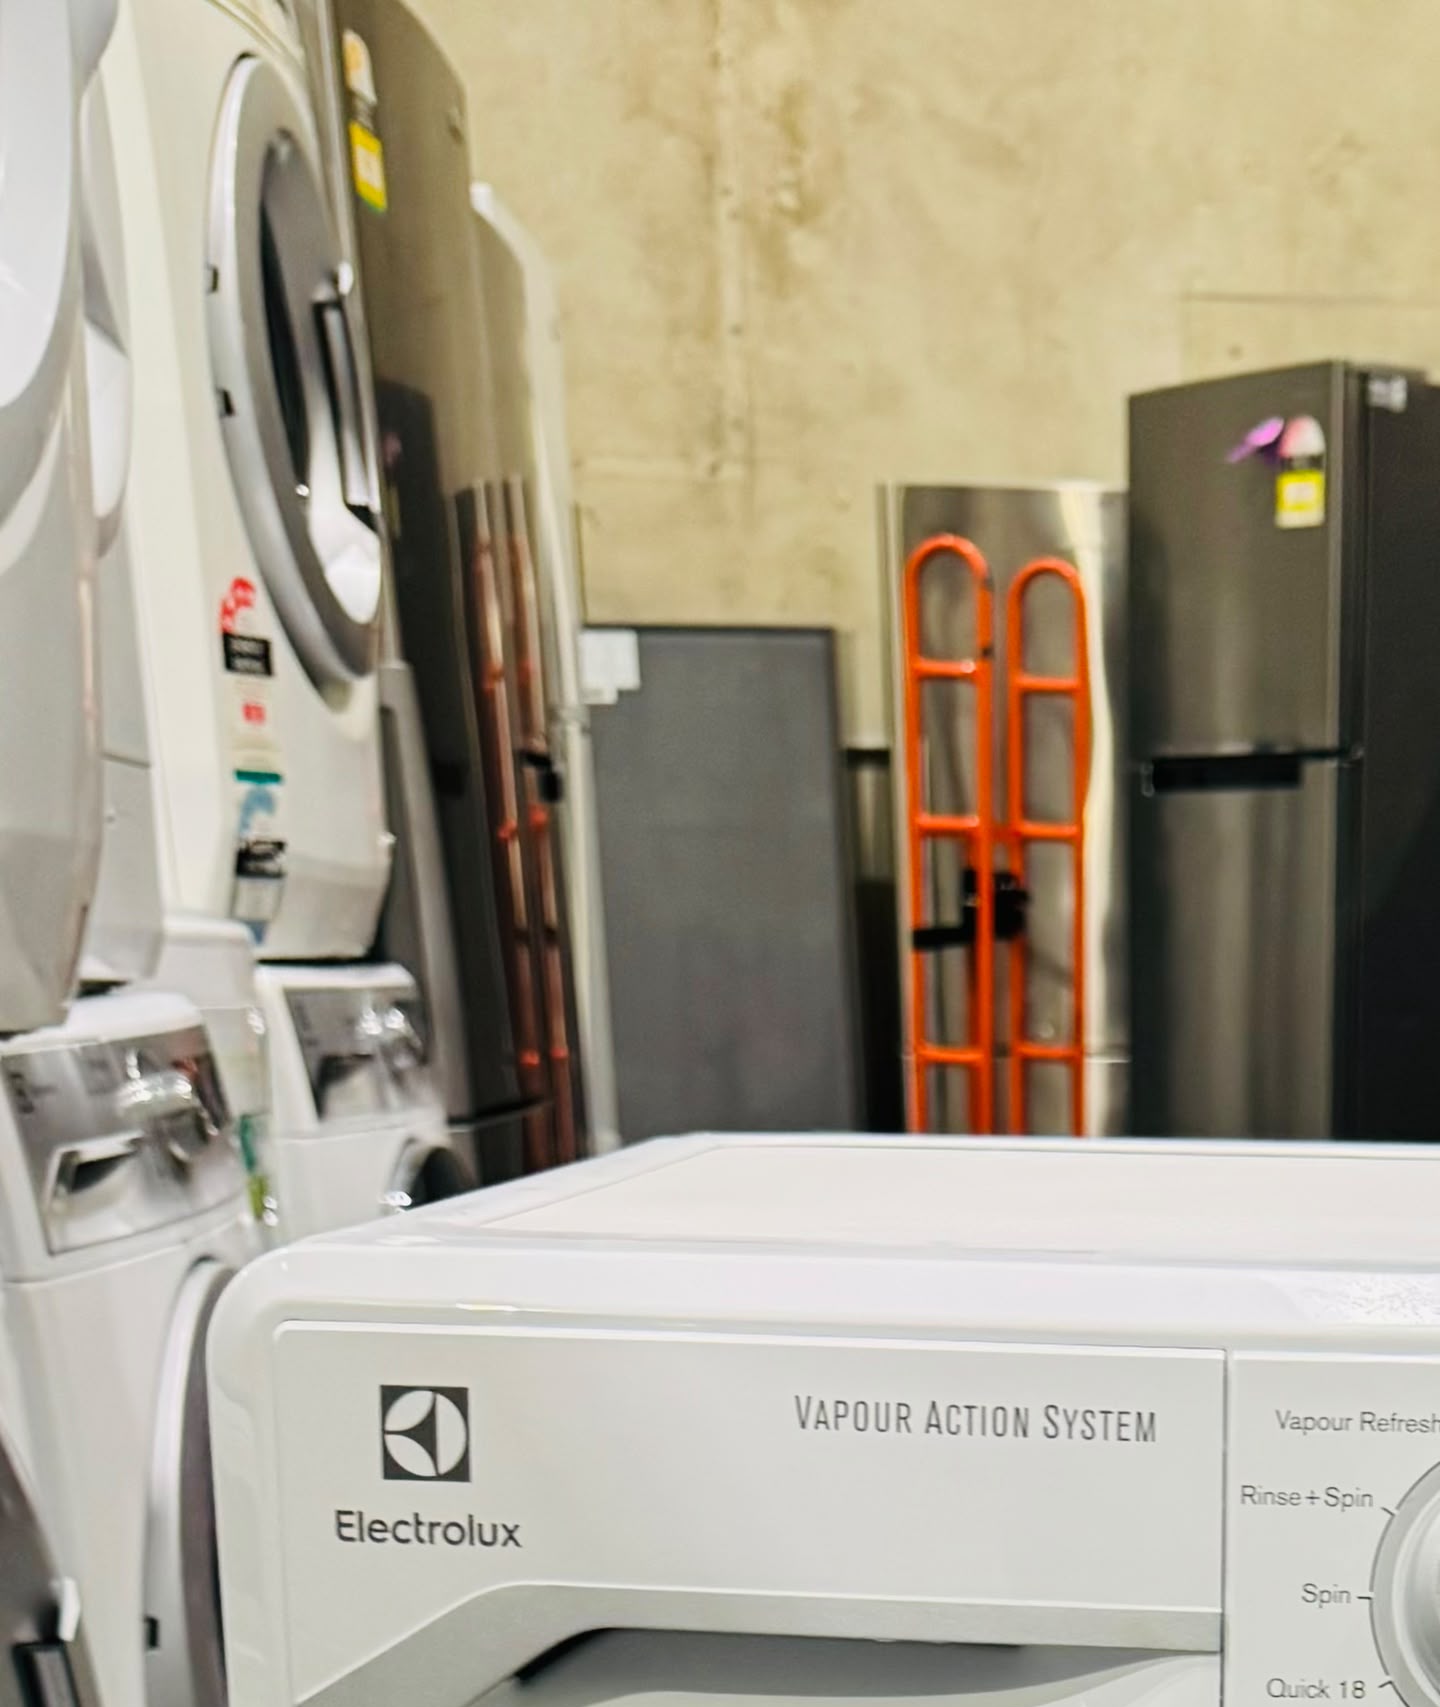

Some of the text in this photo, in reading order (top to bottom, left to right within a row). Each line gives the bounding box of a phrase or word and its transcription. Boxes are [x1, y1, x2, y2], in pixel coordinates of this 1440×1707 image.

[1275, 1410, 1352, 1435] Vapour
[334, 1510, 522, 1549] Electrolux
[1301, 1584, 1352, 1608] Spin
[1266, 1678, 1366, 1700] Quick 18
